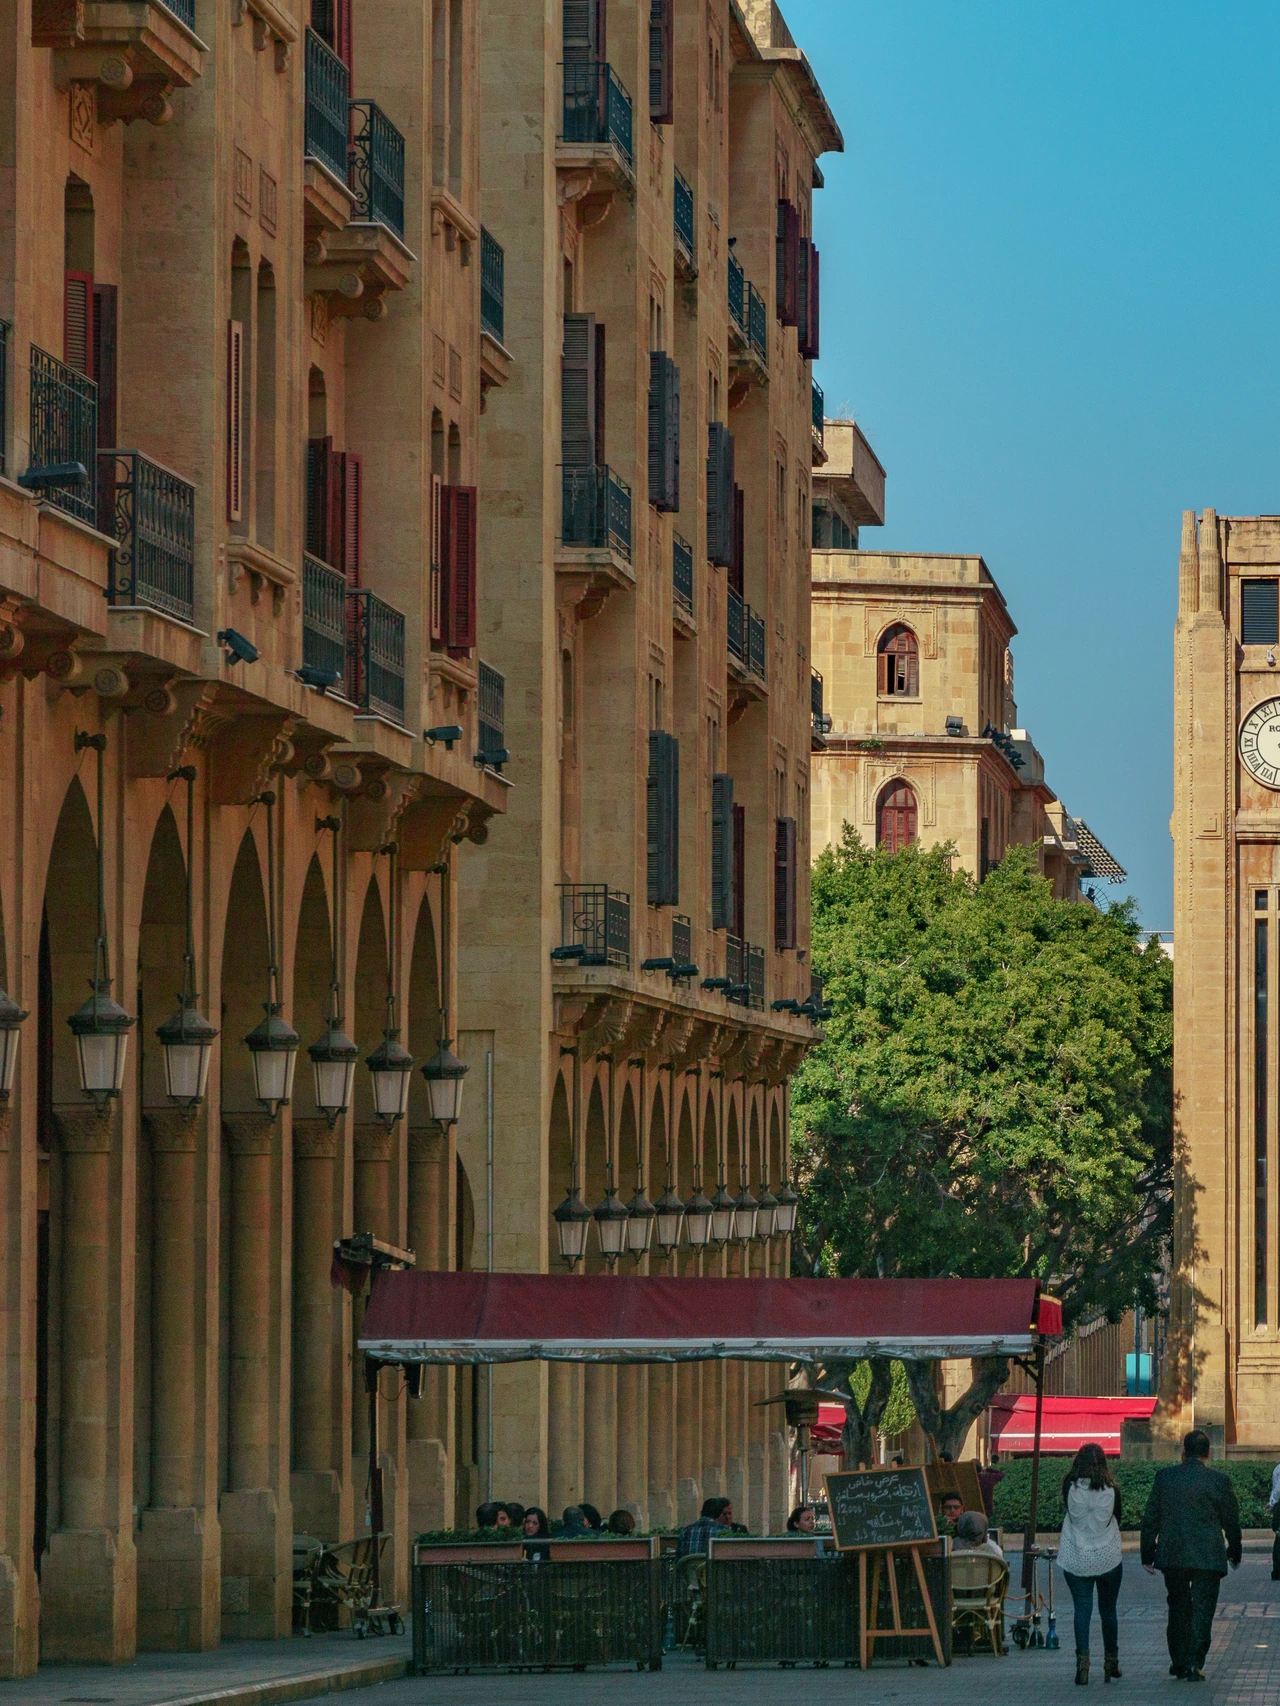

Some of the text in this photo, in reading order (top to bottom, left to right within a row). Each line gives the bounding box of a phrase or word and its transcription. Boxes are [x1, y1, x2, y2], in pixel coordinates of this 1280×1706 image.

[1261, 705, 1273, 718] XI
[1249, 720, 1258, 729] X
[1244, 737, 1253, 748] IX
